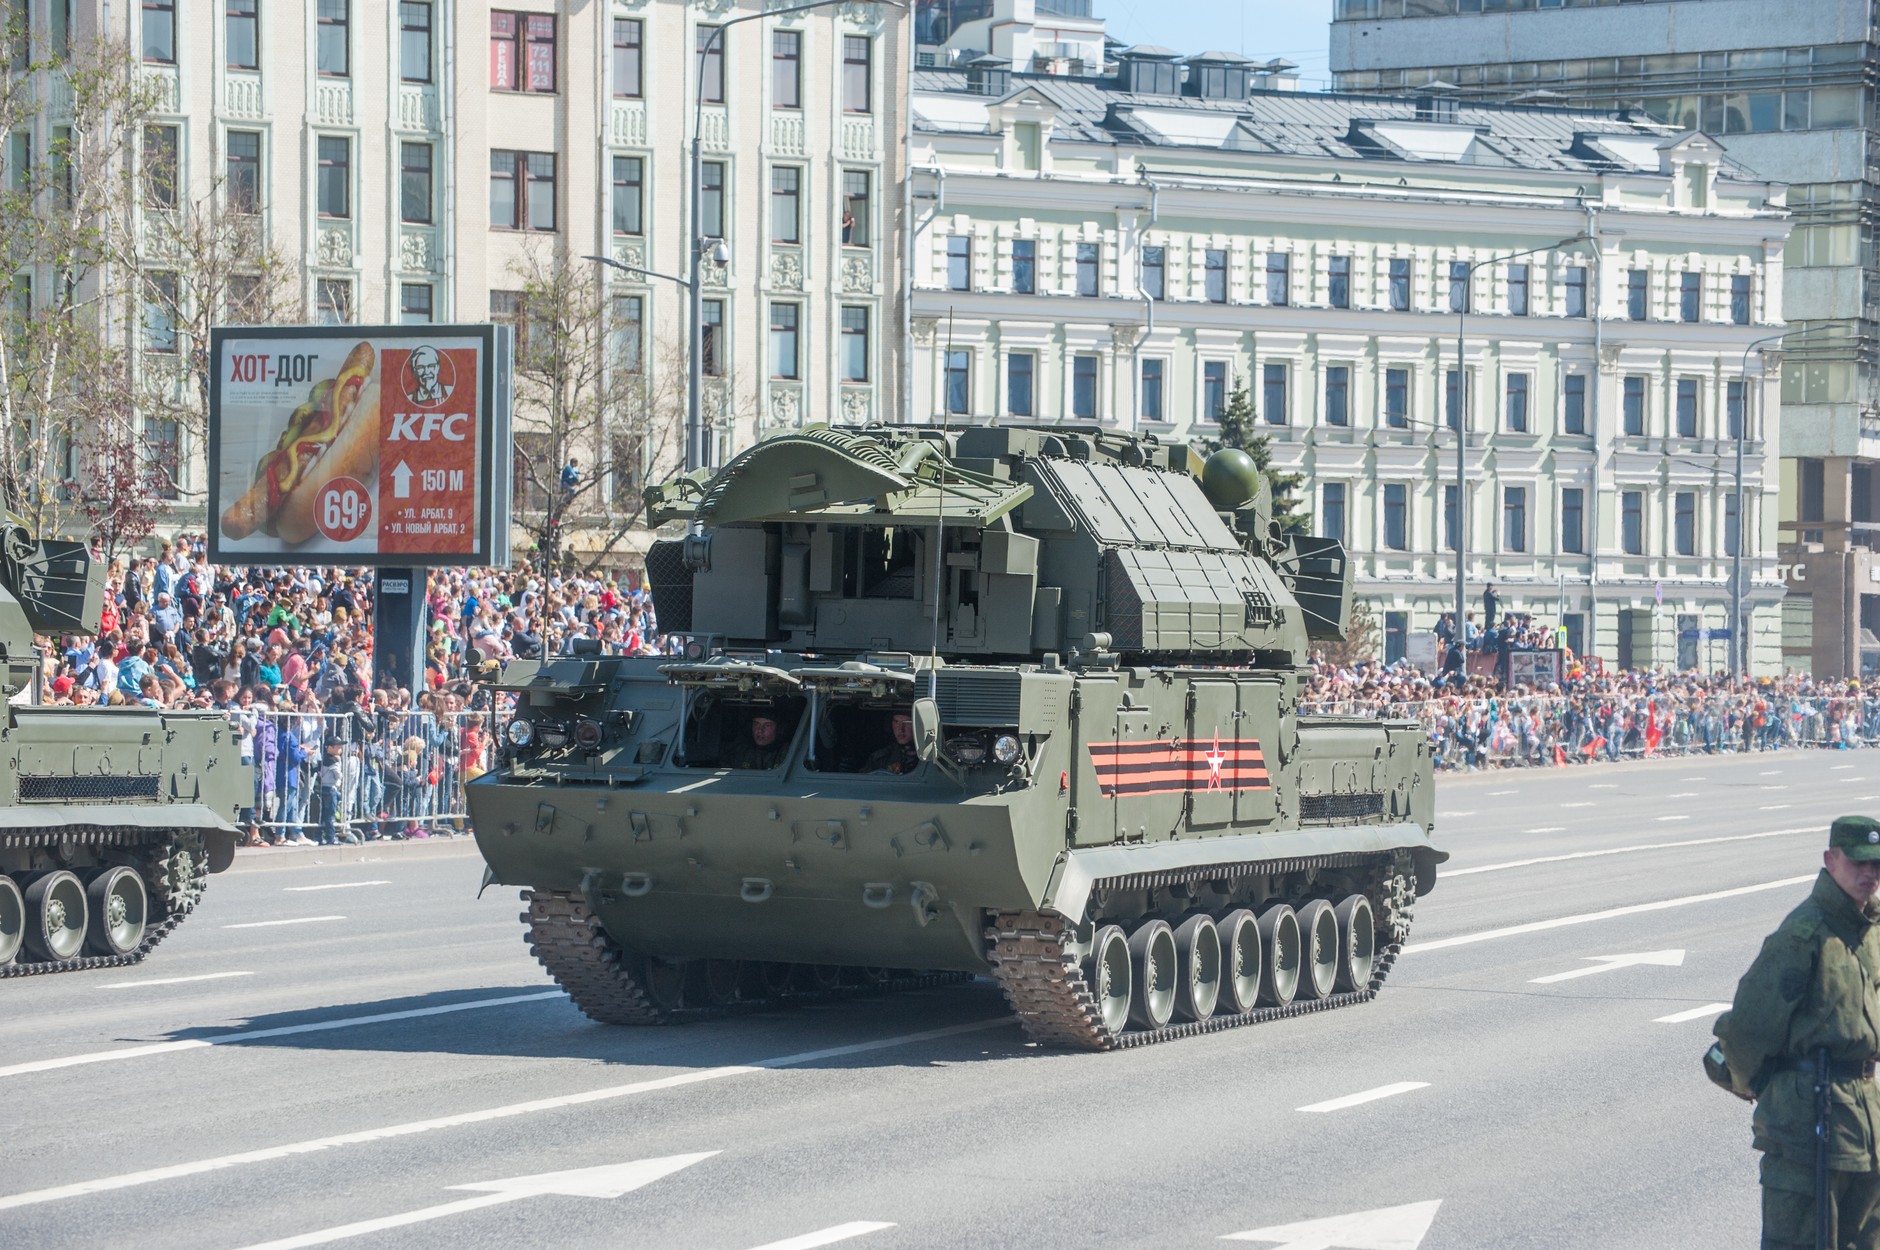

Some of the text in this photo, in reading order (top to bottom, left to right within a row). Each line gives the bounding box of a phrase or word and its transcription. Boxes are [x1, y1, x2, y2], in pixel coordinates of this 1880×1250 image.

[532, 45, 549, 58] 72
[497, 41, 507, 87] АРЕНДА
[530, 60, 550, 73] 111
[532, 74, 549, 87] 23
[230, 354, 318, 387] ХОТ-ДОГ
[387, 413, 468, 441] KFC
[421, 469, 464, 491] 150 М
[404, 508, 453, 520] УЛ. АРБАТ, 9
[391, 521, 465, 535] УЛ. НОВЫЙ АРБАТ, 2
